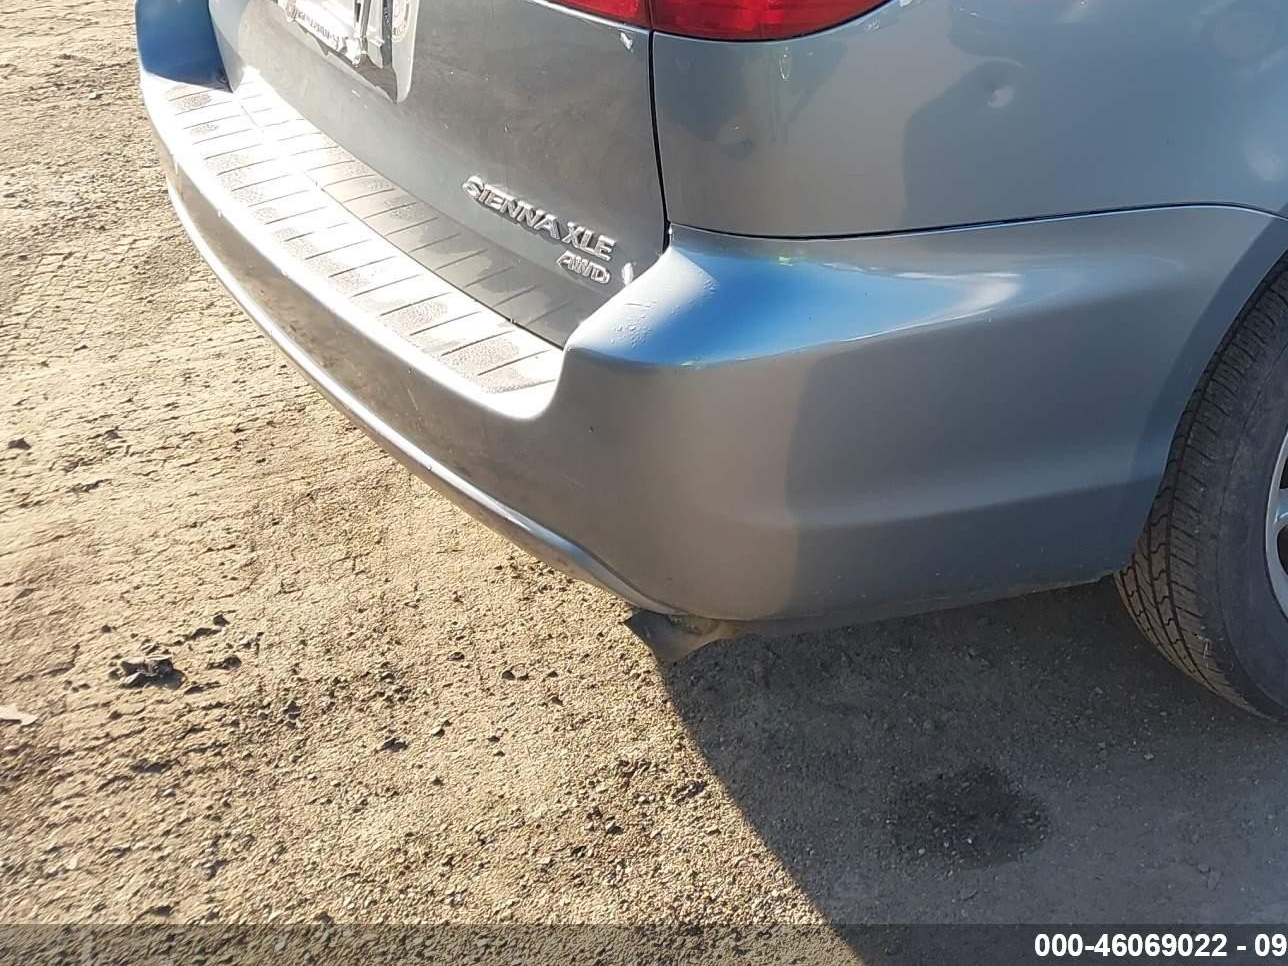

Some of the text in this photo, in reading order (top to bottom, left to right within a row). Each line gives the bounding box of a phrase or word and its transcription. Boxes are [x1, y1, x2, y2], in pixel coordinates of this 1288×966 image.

[462, 175, 617, 261] SIENNA XLE
[556, 249, 611, 284] AWD
